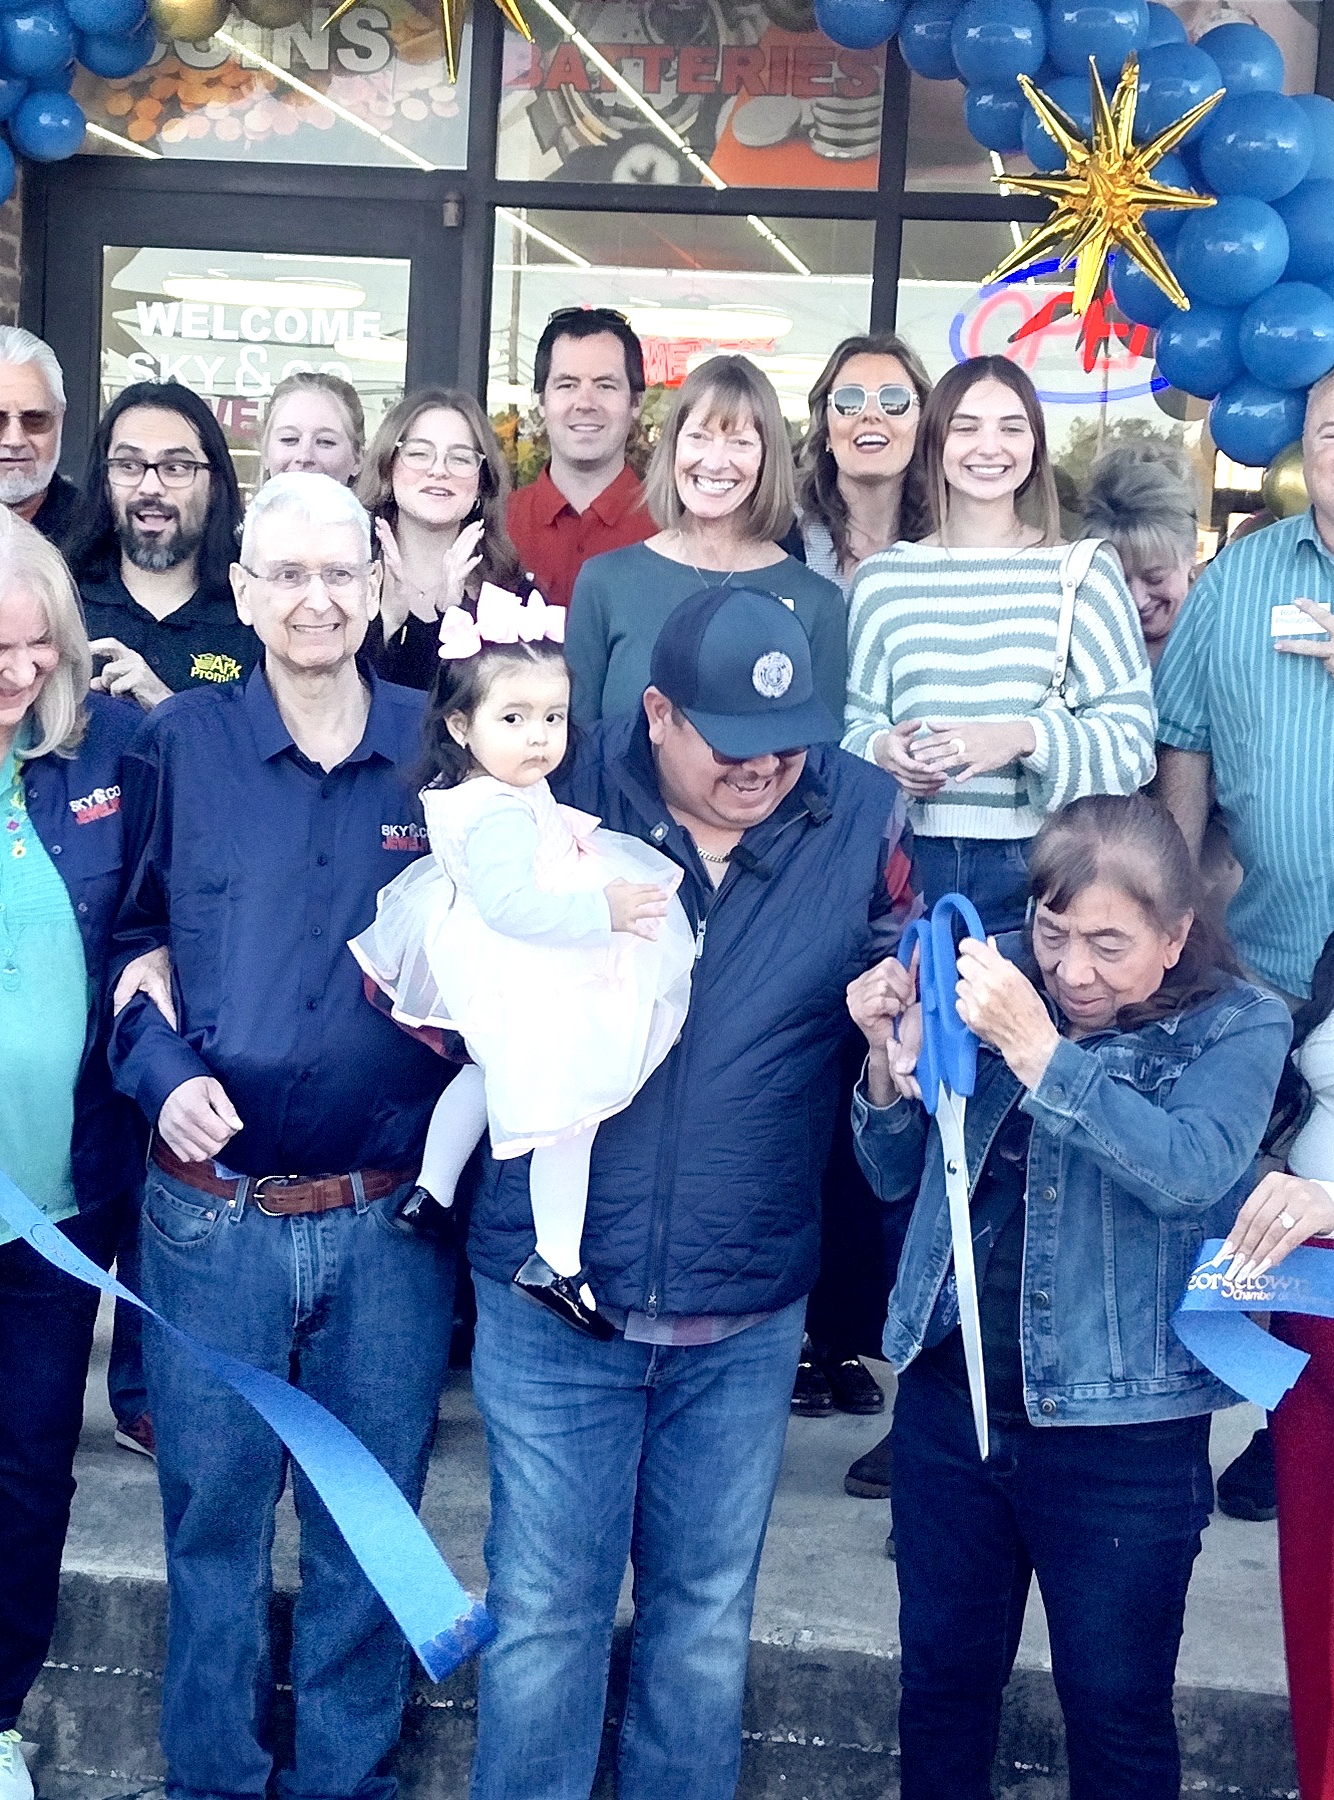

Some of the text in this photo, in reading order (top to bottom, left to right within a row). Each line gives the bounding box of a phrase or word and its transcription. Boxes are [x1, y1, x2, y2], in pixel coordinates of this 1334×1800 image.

[503, 41, 880, 97] BATTERIES
[136, 301, 382, 345] WELCOME
[125, 352, 226, 391] SKY
[235, 344, 275, 397] &
